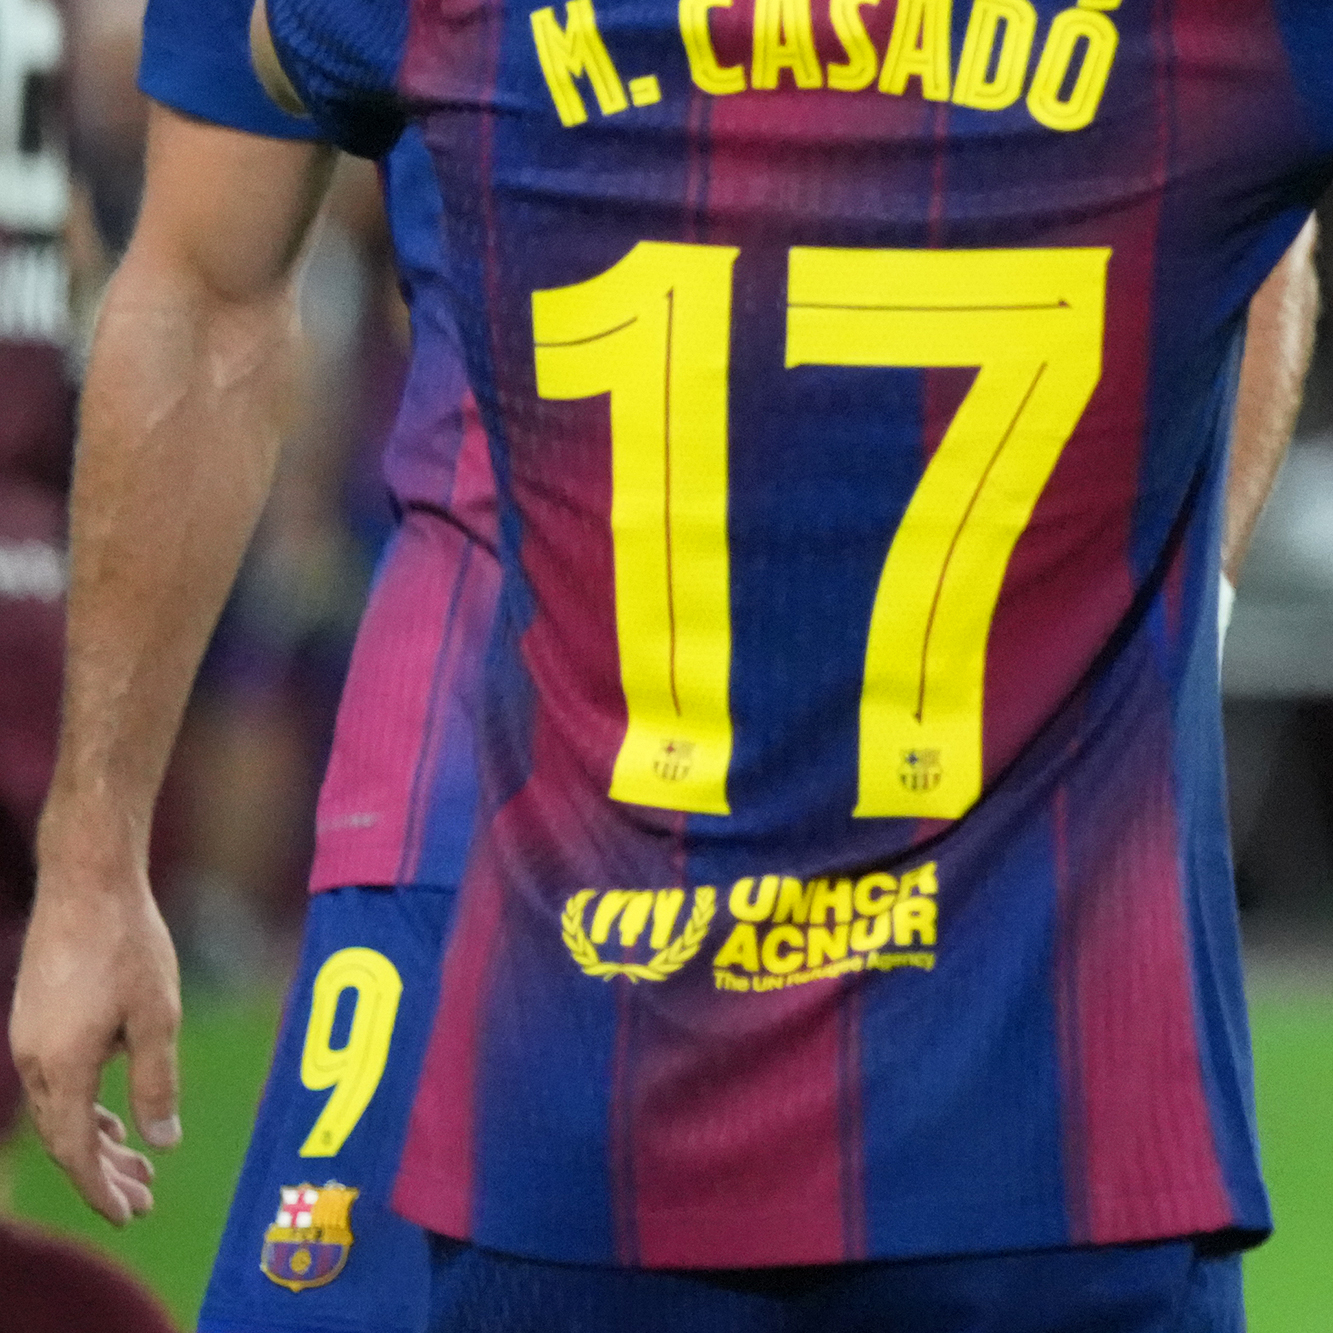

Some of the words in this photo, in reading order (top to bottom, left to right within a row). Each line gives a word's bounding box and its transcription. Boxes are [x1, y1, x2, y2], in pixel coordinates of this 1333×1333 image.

[531, 240, 1114, 821] 17
[713, 897, 939, 975] ACNUR
[728, 861, 939, 925] UNHCR
[300, 947, 403, 1157] 9
